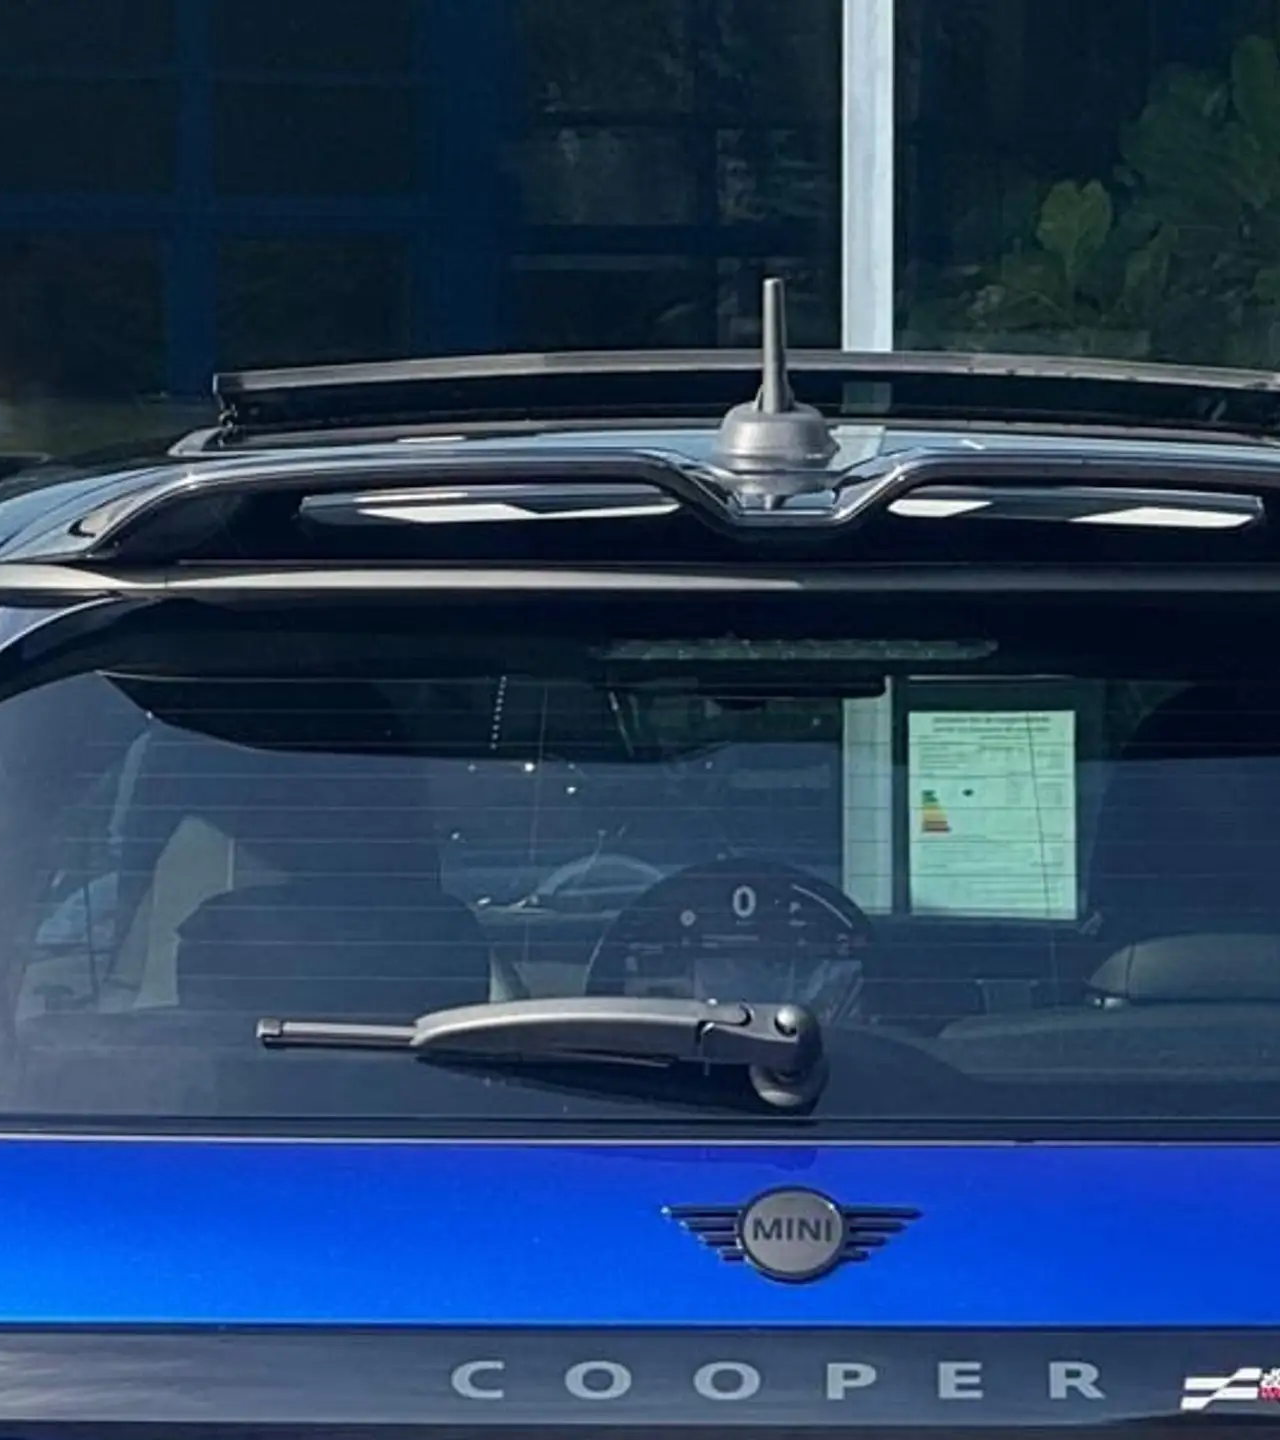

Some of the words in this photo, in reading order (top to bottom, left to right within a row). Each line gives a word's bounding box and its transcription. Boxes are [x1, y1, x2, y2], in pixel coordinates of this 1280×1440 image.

[732, 885, 757, 918] 0
[752, 1217, 833, 1243] MINI
[451, 1360, 1106, 1400] COOPER
